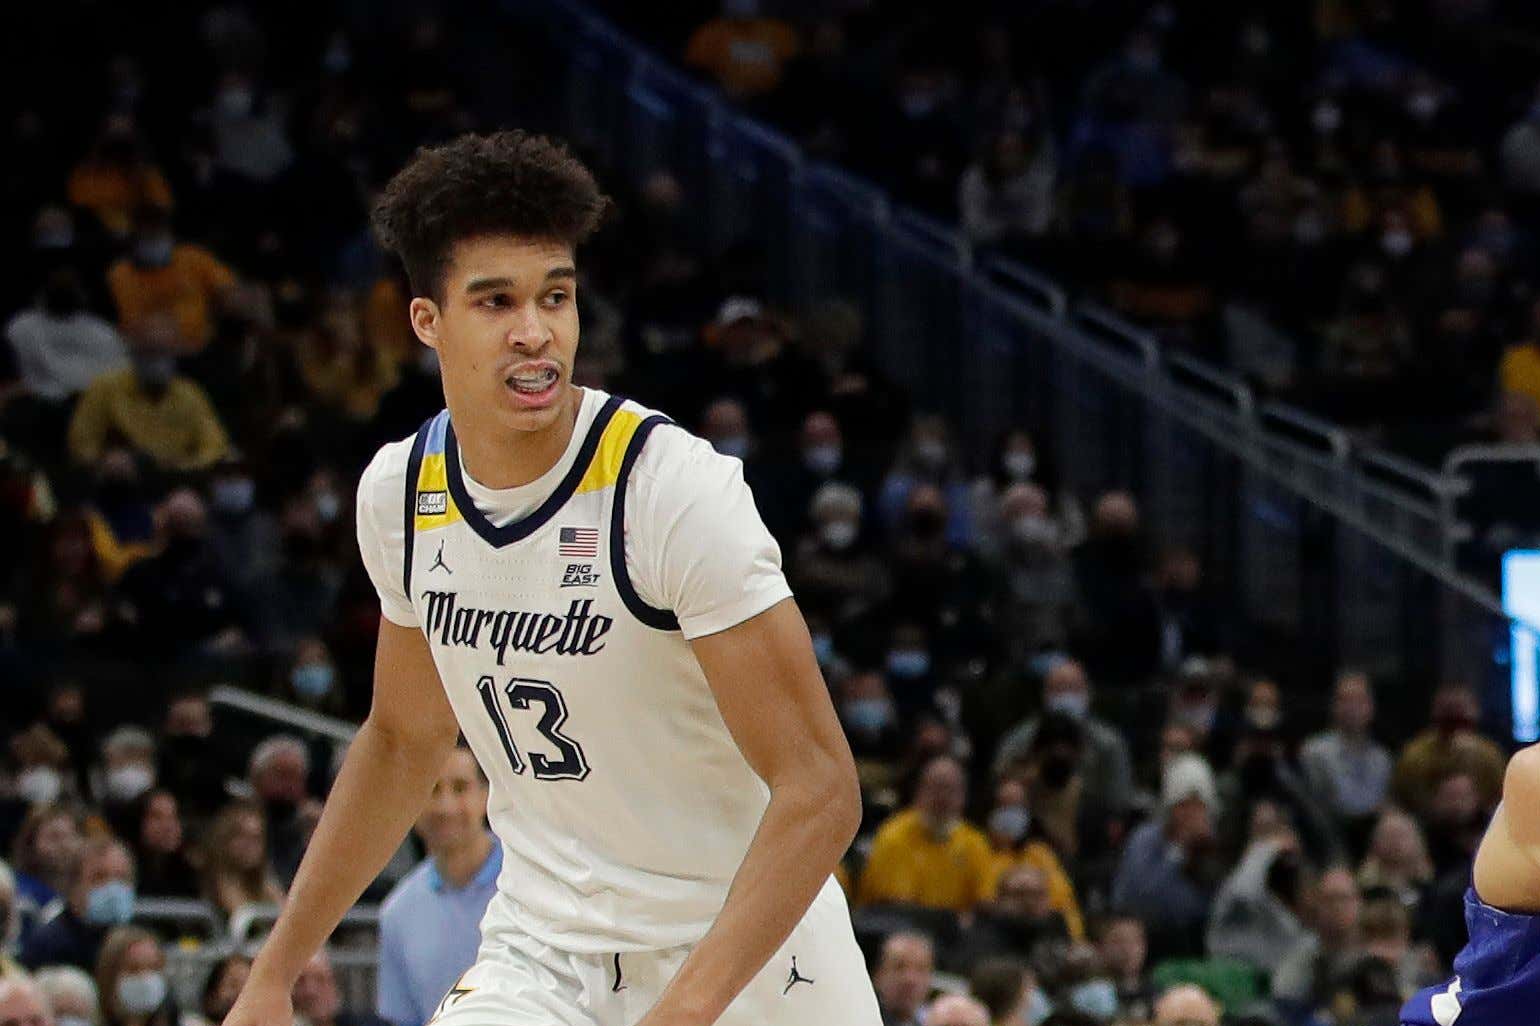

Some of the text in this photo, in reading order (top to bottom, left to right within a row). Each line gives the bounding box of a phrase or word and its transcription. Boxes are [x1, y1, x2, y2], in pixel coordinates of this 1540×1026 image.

[562, 574, 601, 584] EAST
[565, 563, 593, 575] BIG
[421, 590, 613, 666] Marquette
[477, 675, 592, 782] 13
